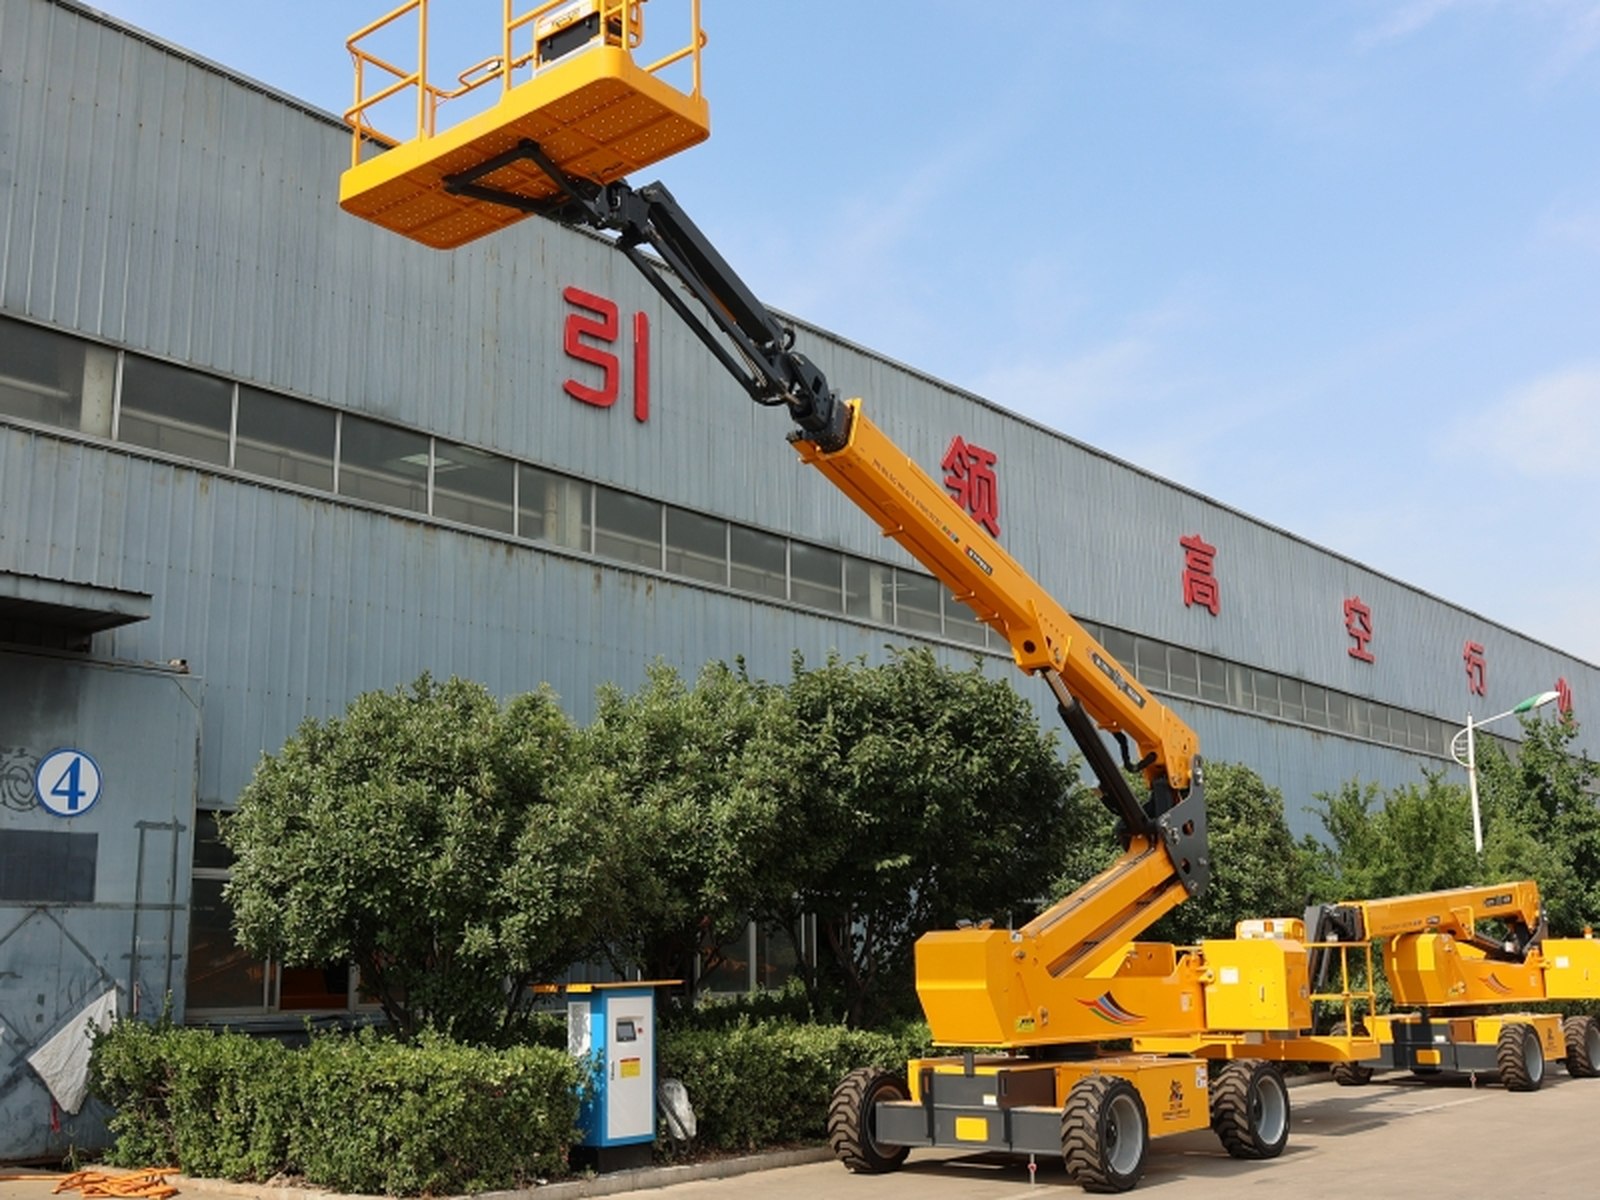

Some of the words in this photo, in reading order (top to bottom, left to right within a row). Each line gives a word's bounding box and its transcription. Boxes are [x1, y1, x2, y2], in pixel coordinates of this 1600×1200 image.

[563, 286, 649, 423] 引
[941, 435, 1000, 539] 领
[1180, 534, 1220, 616] 高
[1343, 597, 1375, 663] 空
[1463, 640, 1488, 697] 行
[51, 757, 86, 810] 4
